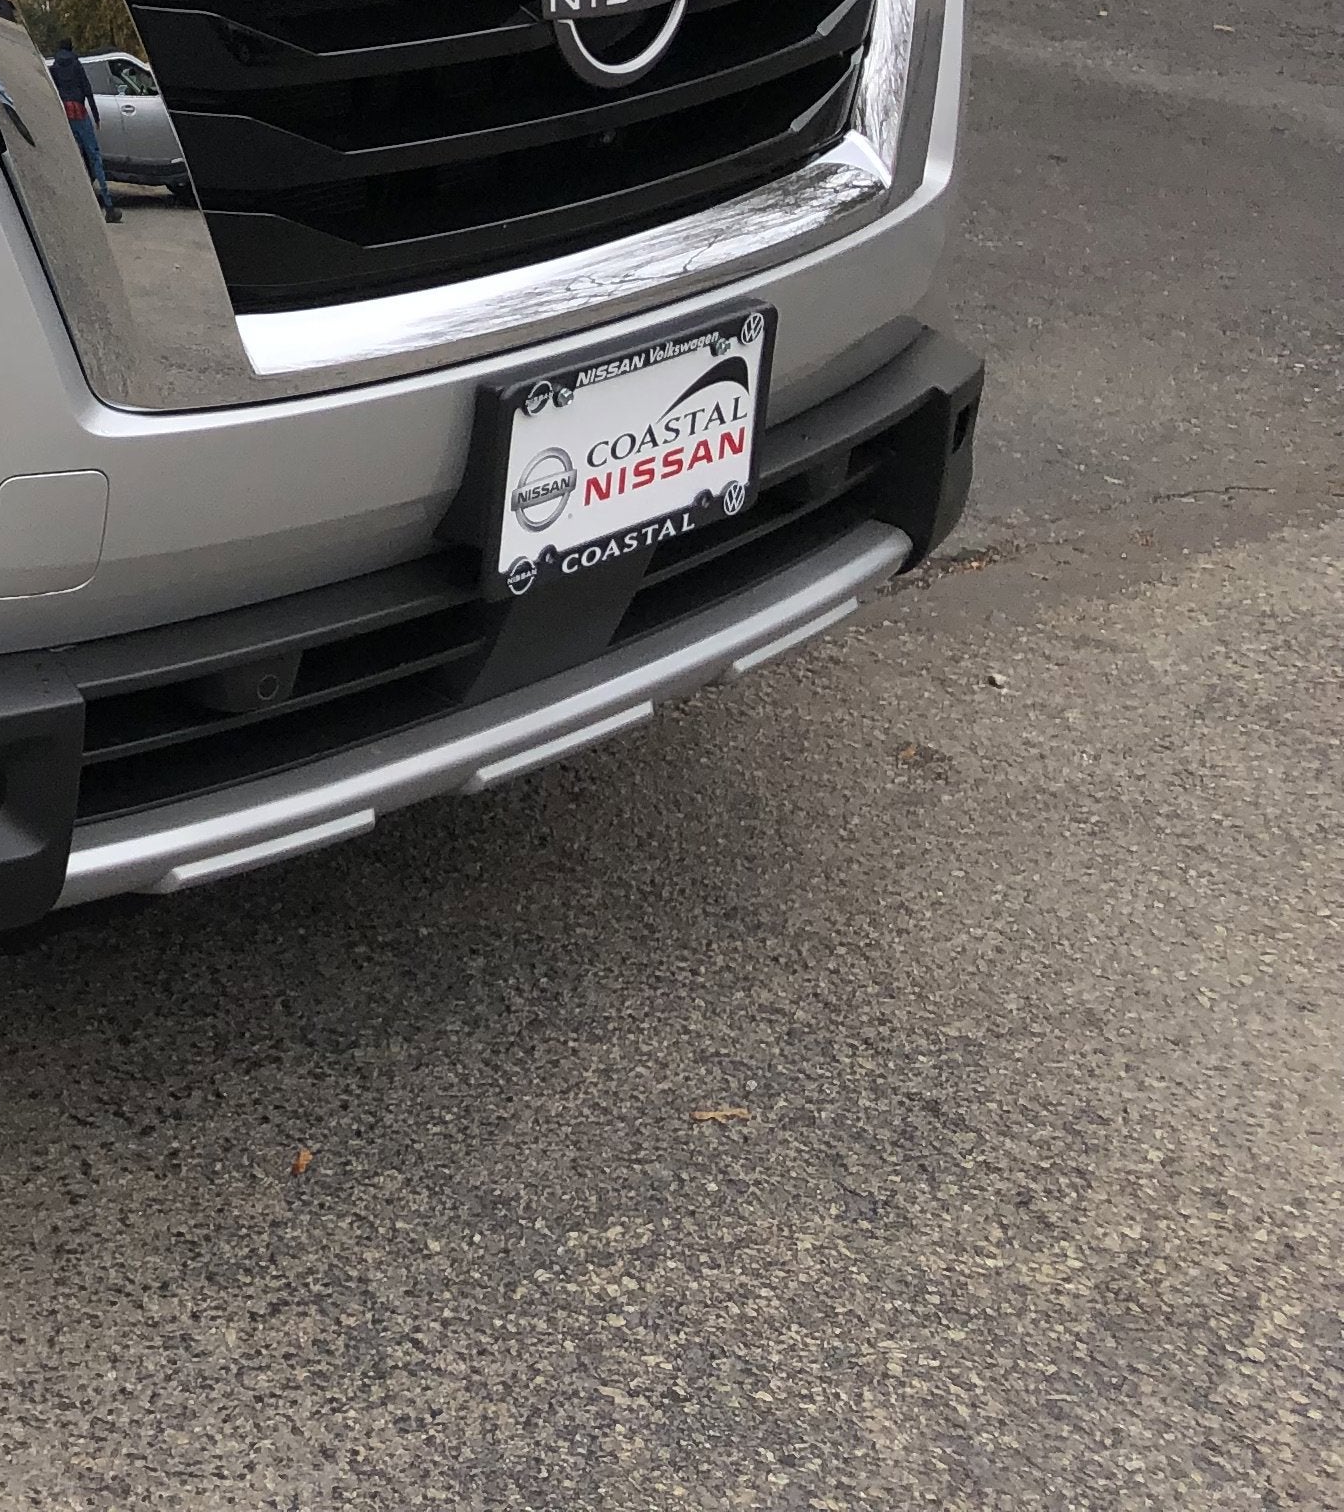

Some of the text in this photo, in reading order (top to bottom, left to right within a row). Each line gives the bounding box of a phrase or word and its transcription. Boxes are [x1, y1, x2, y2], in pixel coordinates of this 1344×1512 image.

[576, 331, 720, 387] NISSAN Volkswagen
[586, 396, 748, 468] COASTAL
[518, 476, 571, 503] NISSAN
[583, 427, 745, 506] NISSAN
[562, 512, 695, 574] COASTAL
